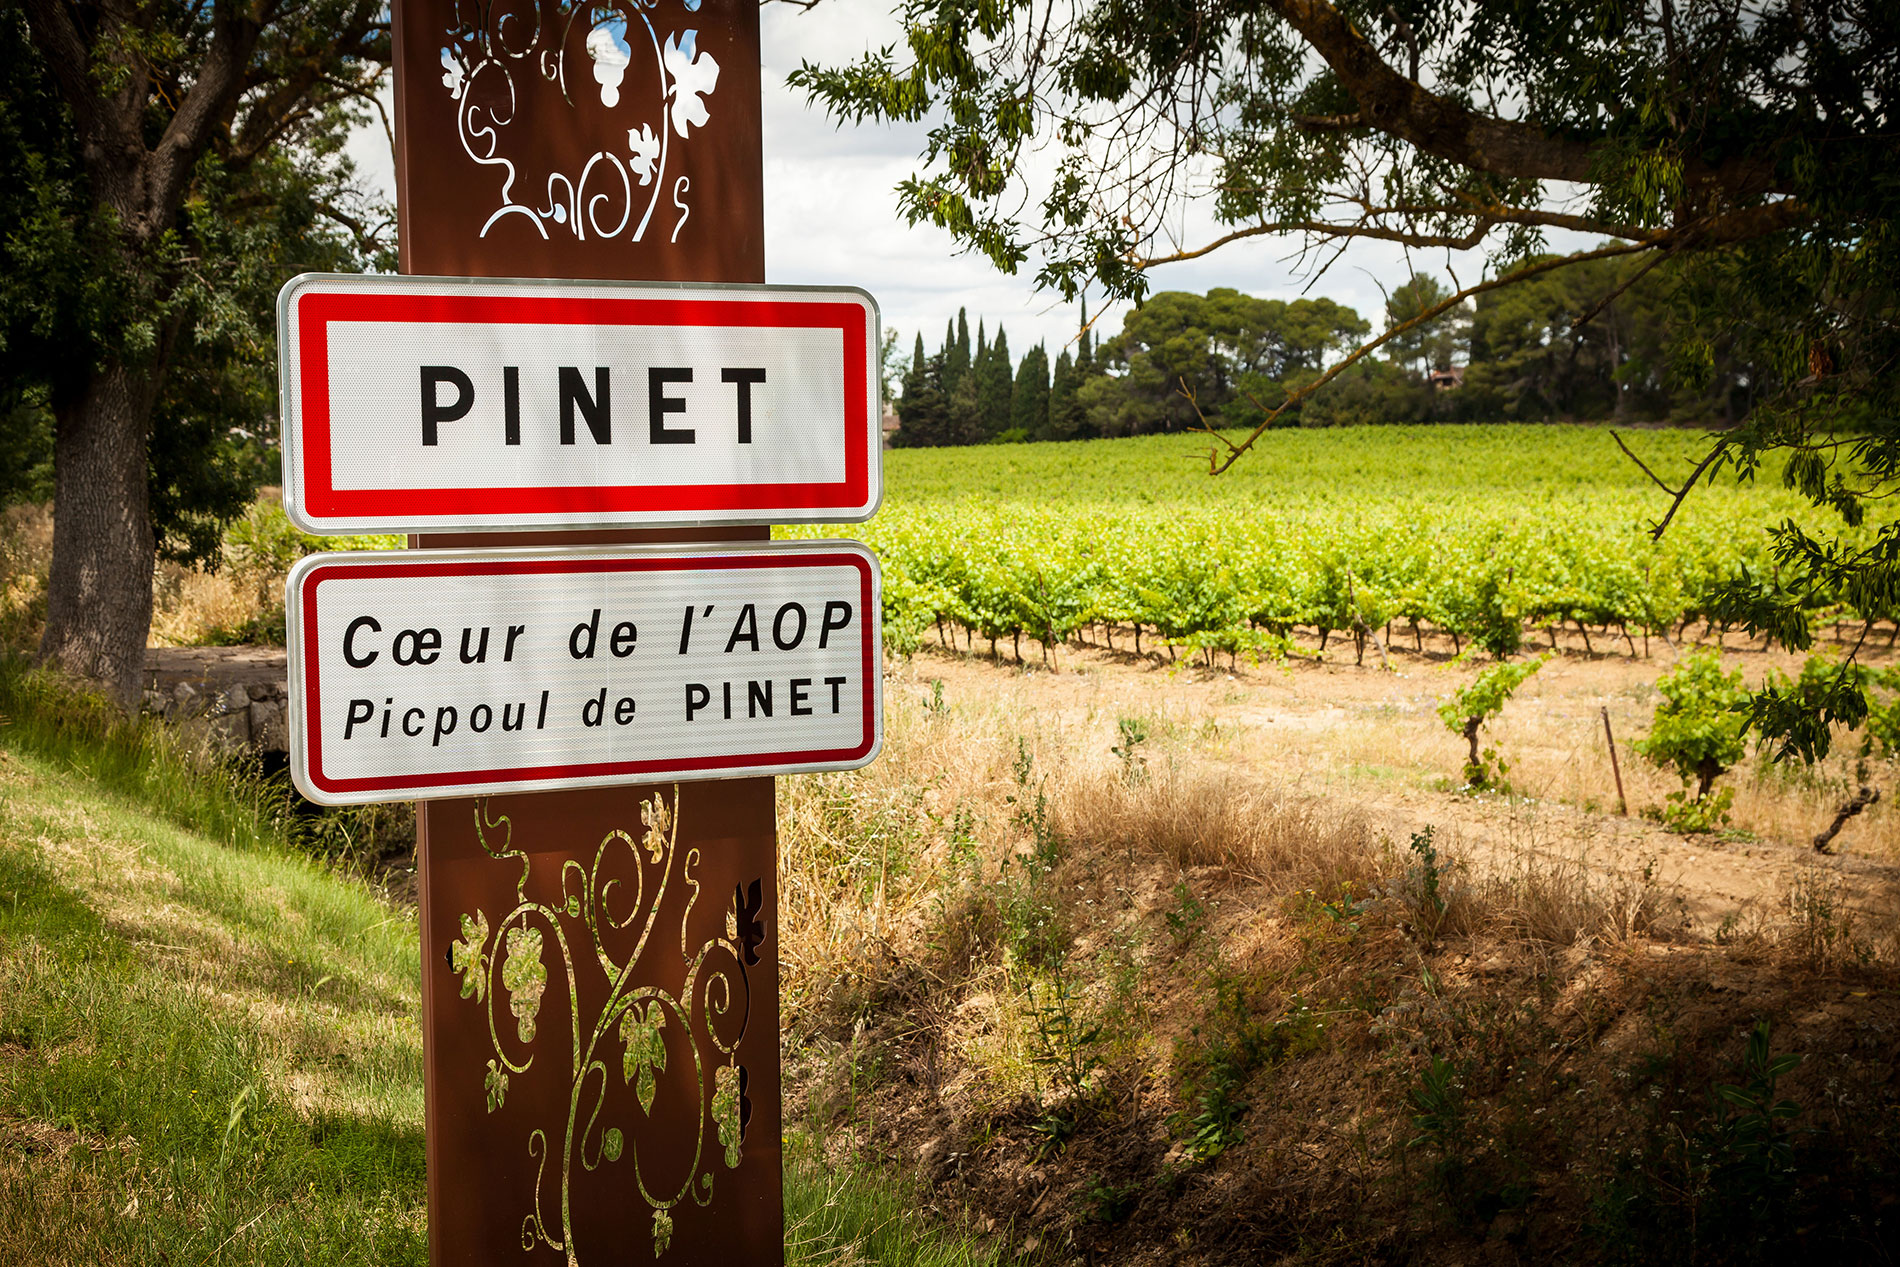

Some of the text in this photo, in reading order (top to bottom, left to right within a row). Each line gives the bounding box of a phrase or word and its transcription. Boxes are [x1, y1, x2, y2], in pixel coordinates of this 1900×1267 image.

[419, 365, 767, 447] PINET
[342, 600, 853, 669] Cœur de l'AOP
[343, 676, 847, 747] Picpoul de PINET
